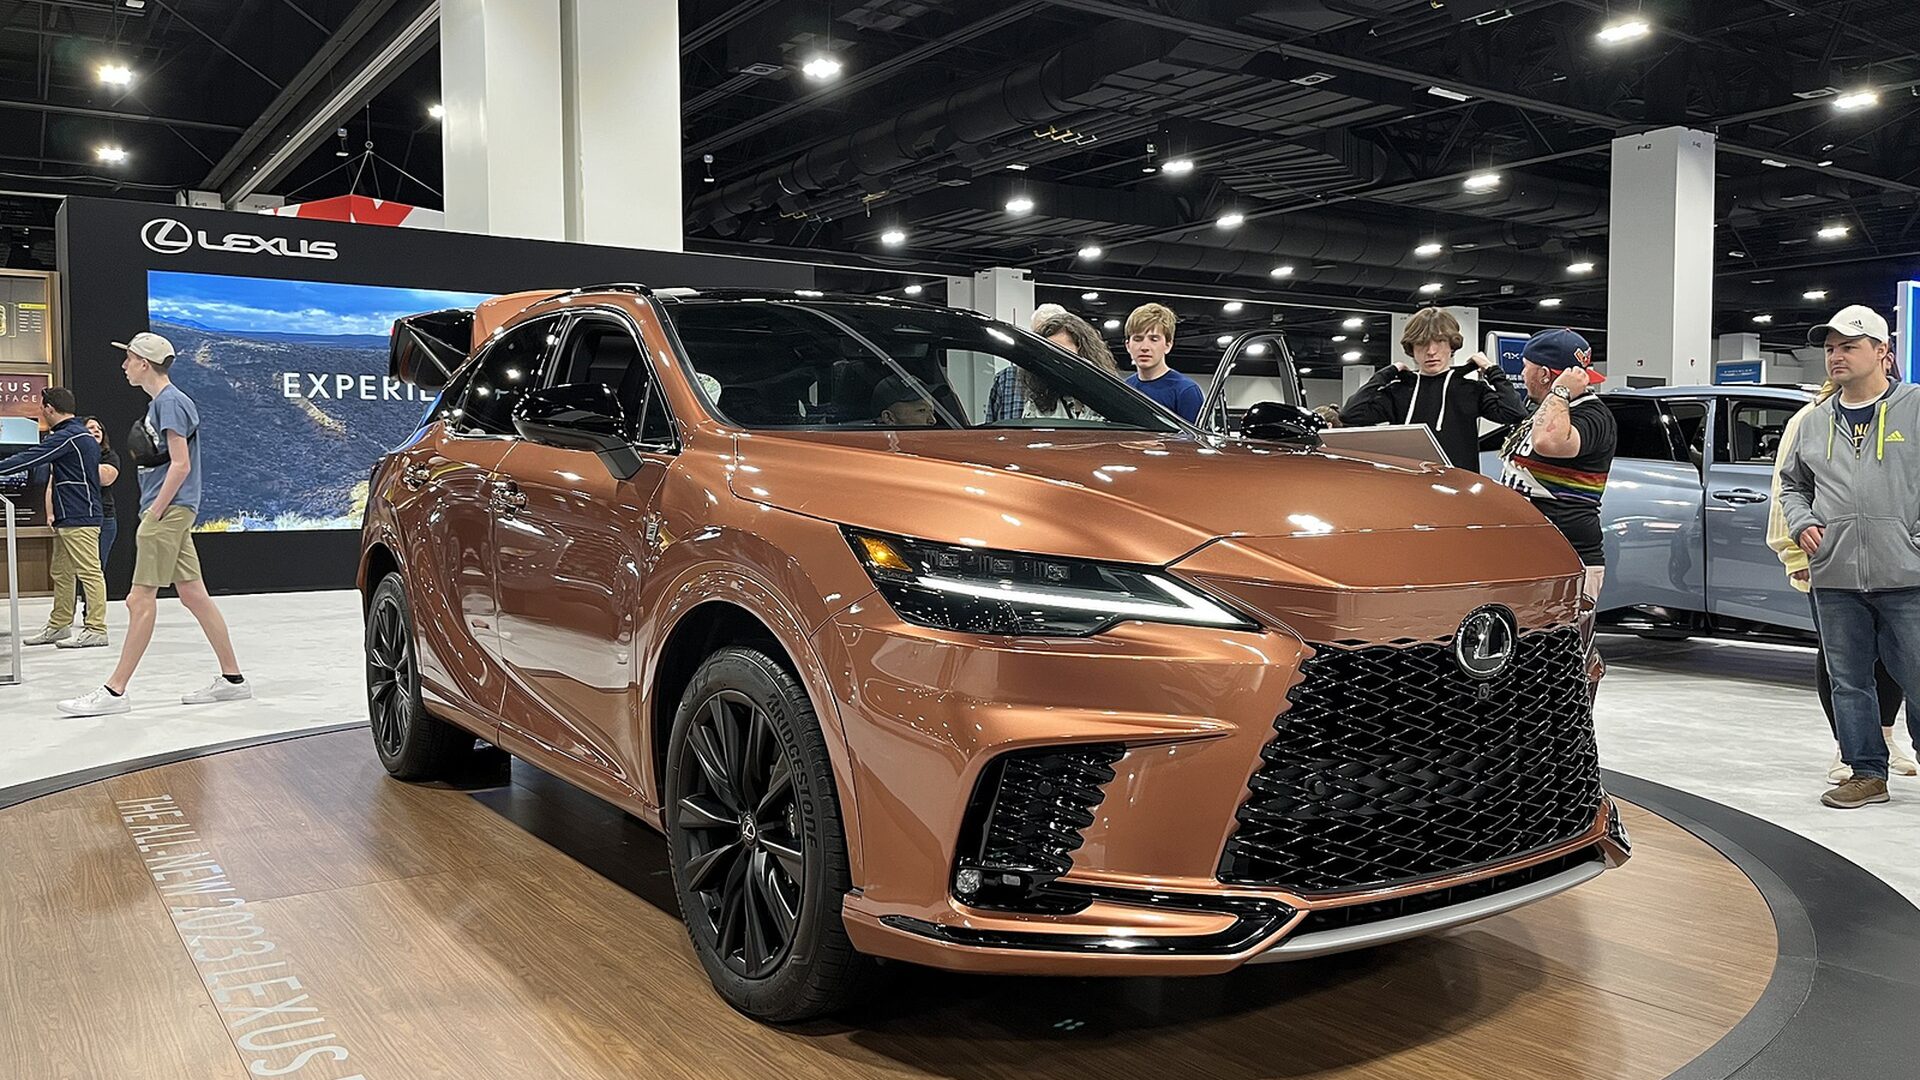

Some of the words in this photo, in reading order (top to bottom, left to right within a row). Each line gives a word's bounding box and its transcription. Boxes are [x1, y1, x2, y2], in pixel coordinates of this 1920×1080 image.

[197, 230, 339, 260] LEXUS
[766, 692, 817, 849] BRIDGESTONE
[116, 794, 184, 823] THE
[170, 898, 276, 961] 2023
[206, 961, 349, 1076] LEXUS
